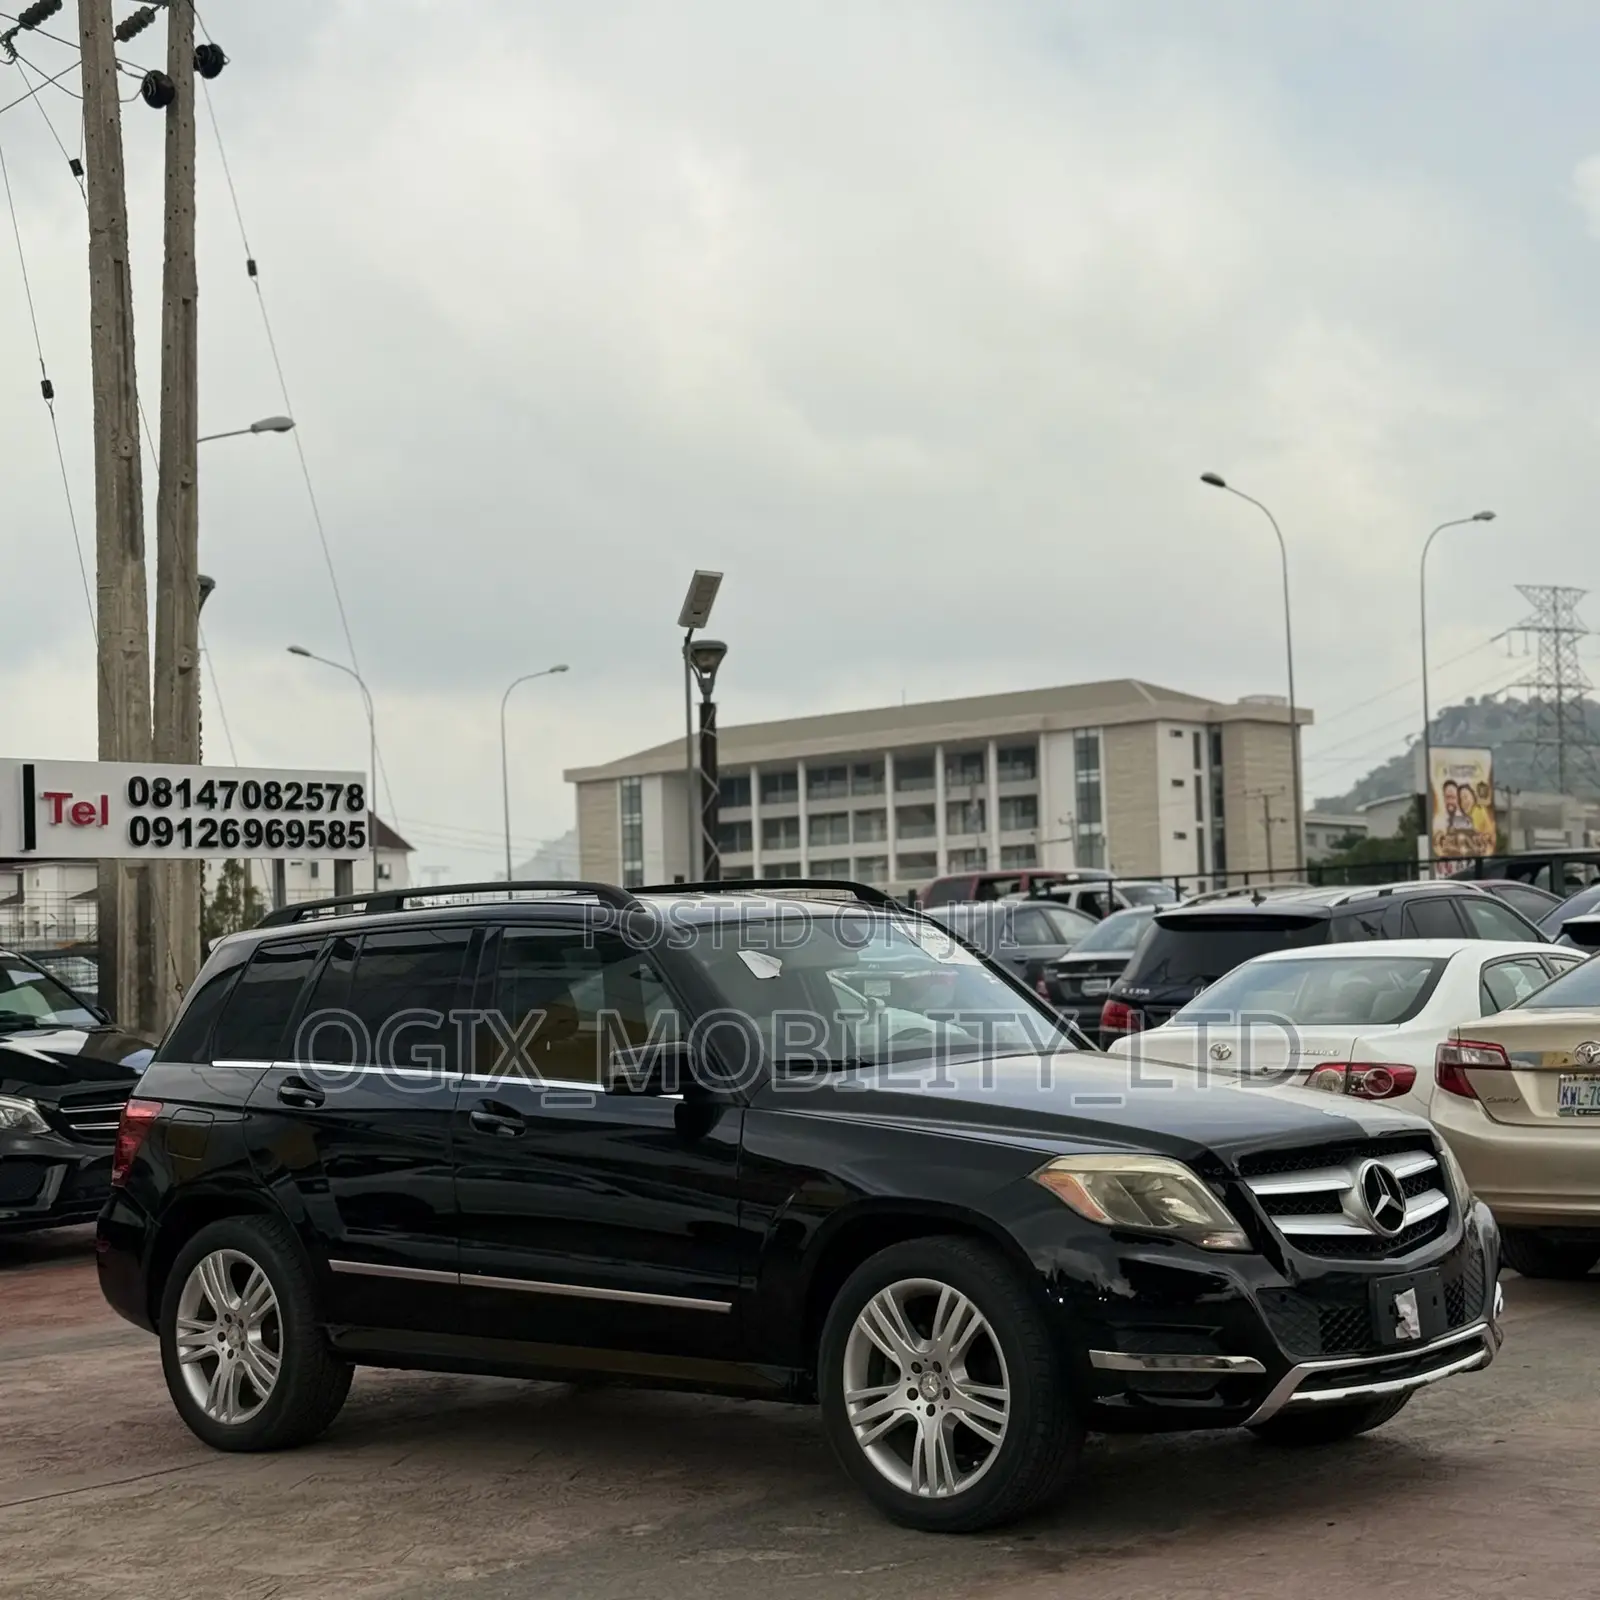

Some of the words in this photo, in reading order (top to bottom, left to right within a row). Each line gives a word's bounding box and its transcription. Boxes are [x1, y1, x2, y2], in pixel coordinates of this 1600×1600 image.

[41, 791, 109, 829] Tel
[127, 775, 366, 813] 08147082578
[127, 815, 366, 850] 09126969585
